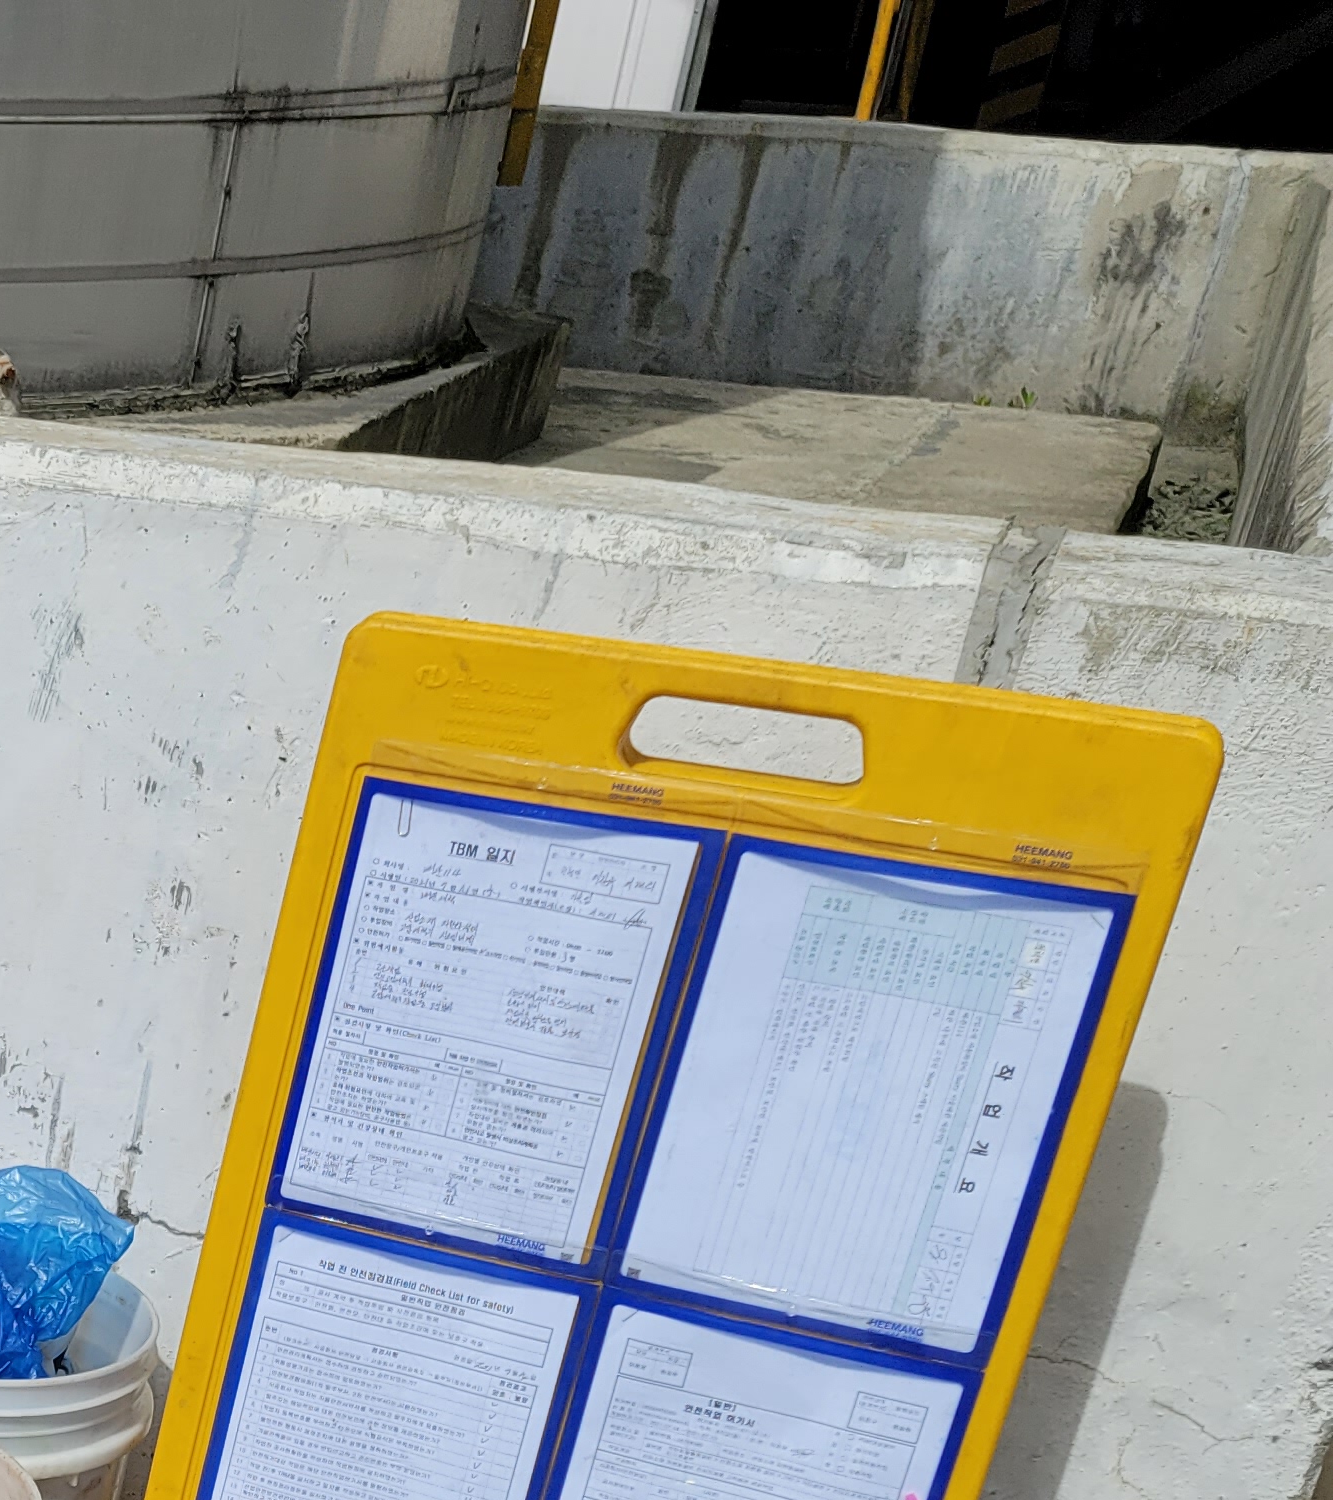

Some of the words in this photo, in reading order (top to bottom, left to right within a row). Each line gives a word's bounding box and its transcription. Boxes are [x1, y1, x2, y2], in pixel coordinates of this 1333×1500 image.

[447, 839, 479, 859] TBM
[484, 844, 517, 865] 일지
[1014, 844, 1074, 860] HEEMANG
[497, 1233, 546, 1251] HEEMANG
[317, 1258, 336, 1272] 작업
[337, 1263, 348, 1275] 전
[417, 1282, 447, 1298] Check
[447, 1289, 465, 1303] List
[465, 1294, 481, 1306] for
[481, 1298, 515, 1316] safety)
[867, 1318, 925, 1337] HEEMANG
